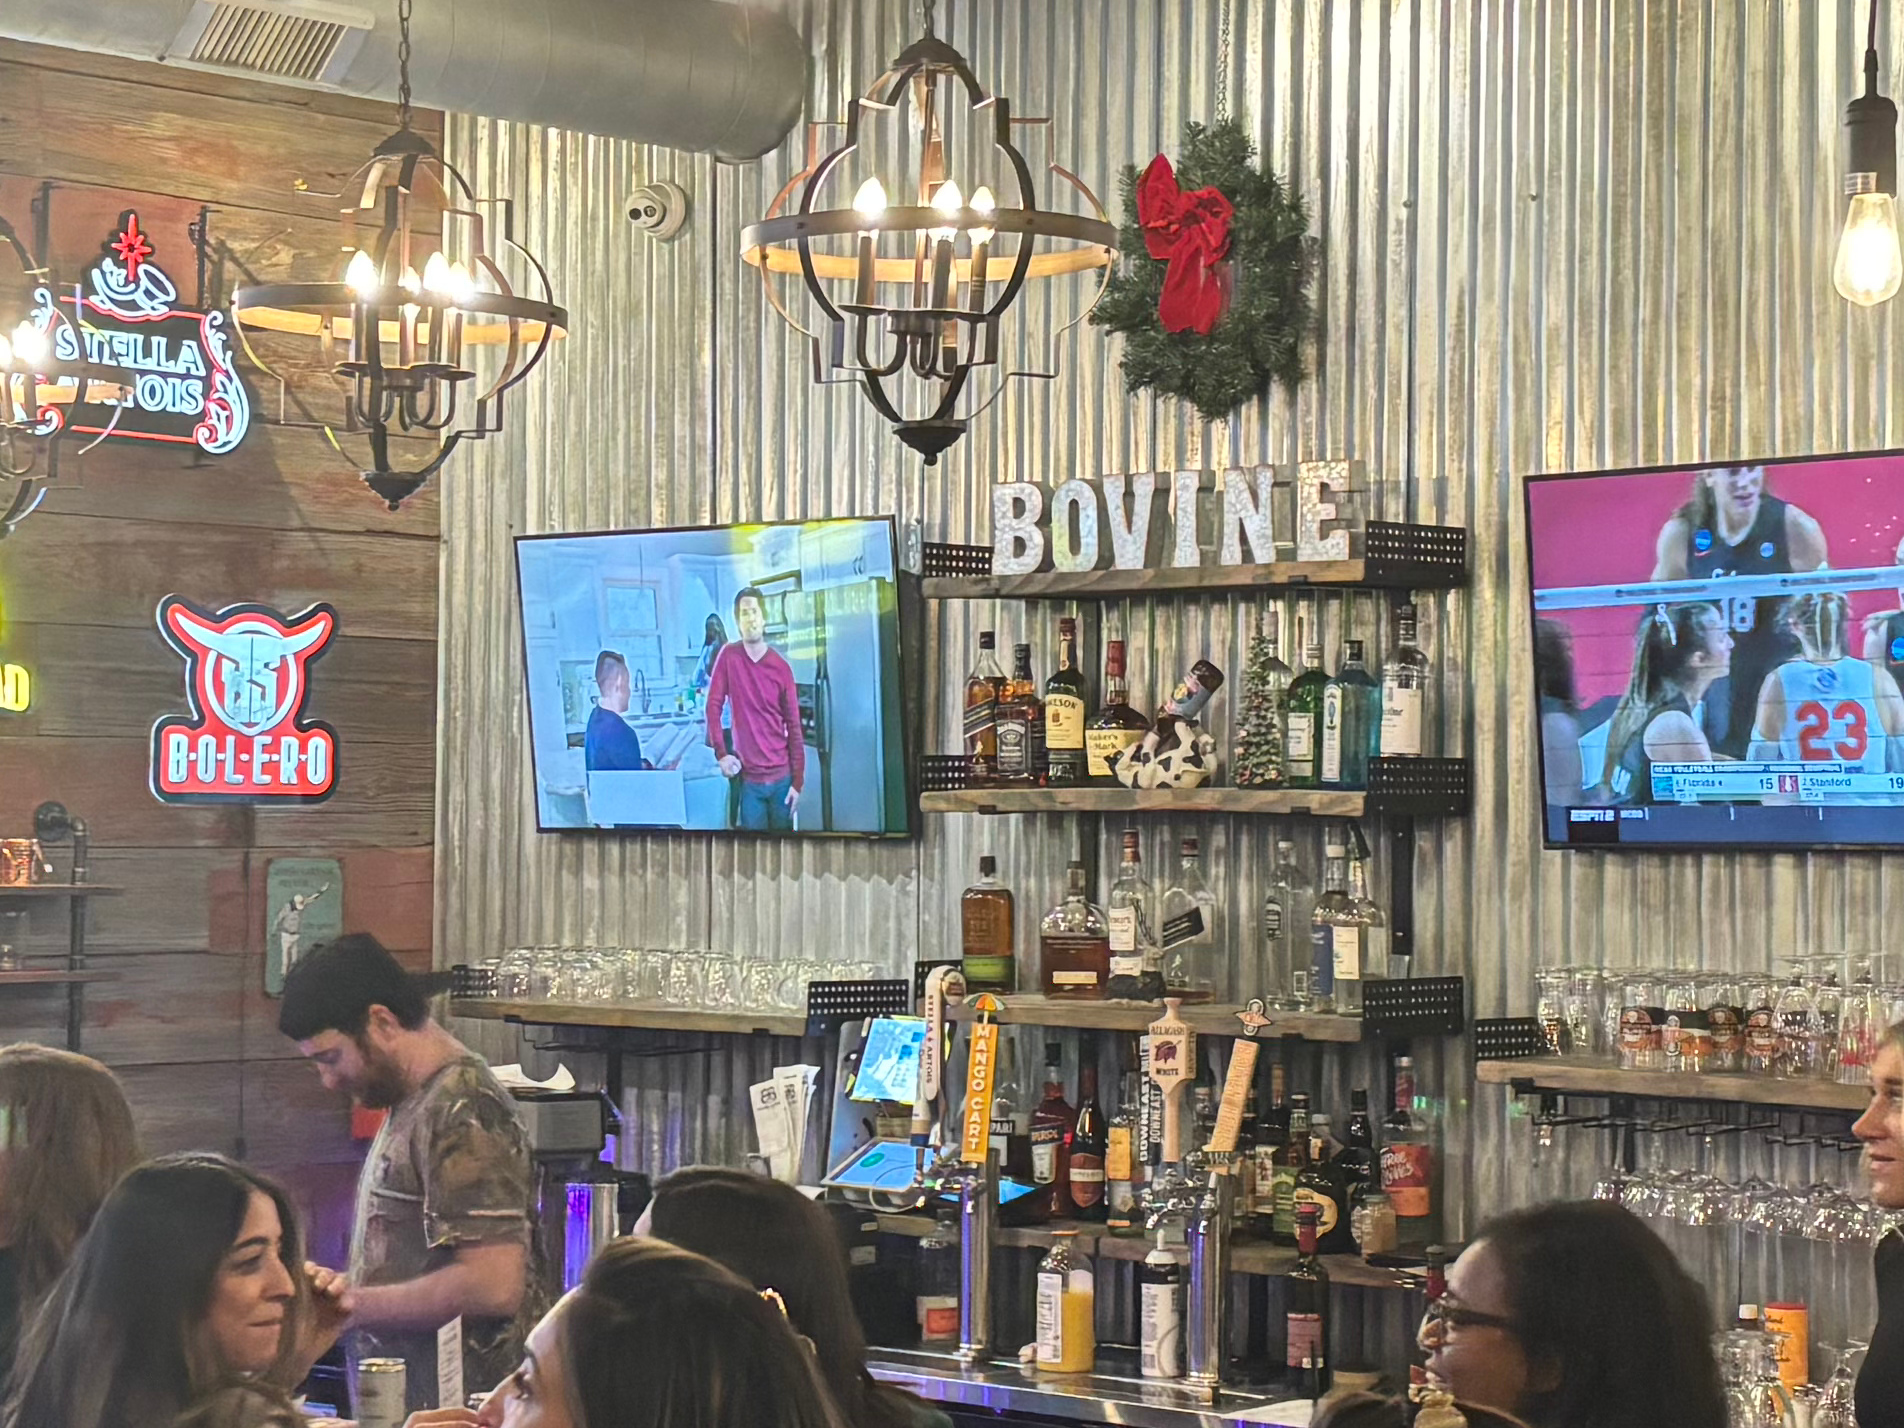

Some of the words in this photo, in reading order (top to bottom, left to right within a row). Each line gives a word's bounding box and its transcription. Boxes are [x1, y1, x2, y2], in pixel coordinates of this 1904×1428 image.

[55, 323, 206, 376] STELLA
[57, 374, 205, 416] OIS
[993, 460, 1351, 576] BOVINE
[1796, 699, 1869, 761] 23
[1759, 777, 1774, 790] 15
[1888, 777, 1904, 789] 19
[971, 1025, 992, 1093] MANGO
[968, 1098, 985, 1150] CART
[990, 1122, 1014, 1134] PARI
